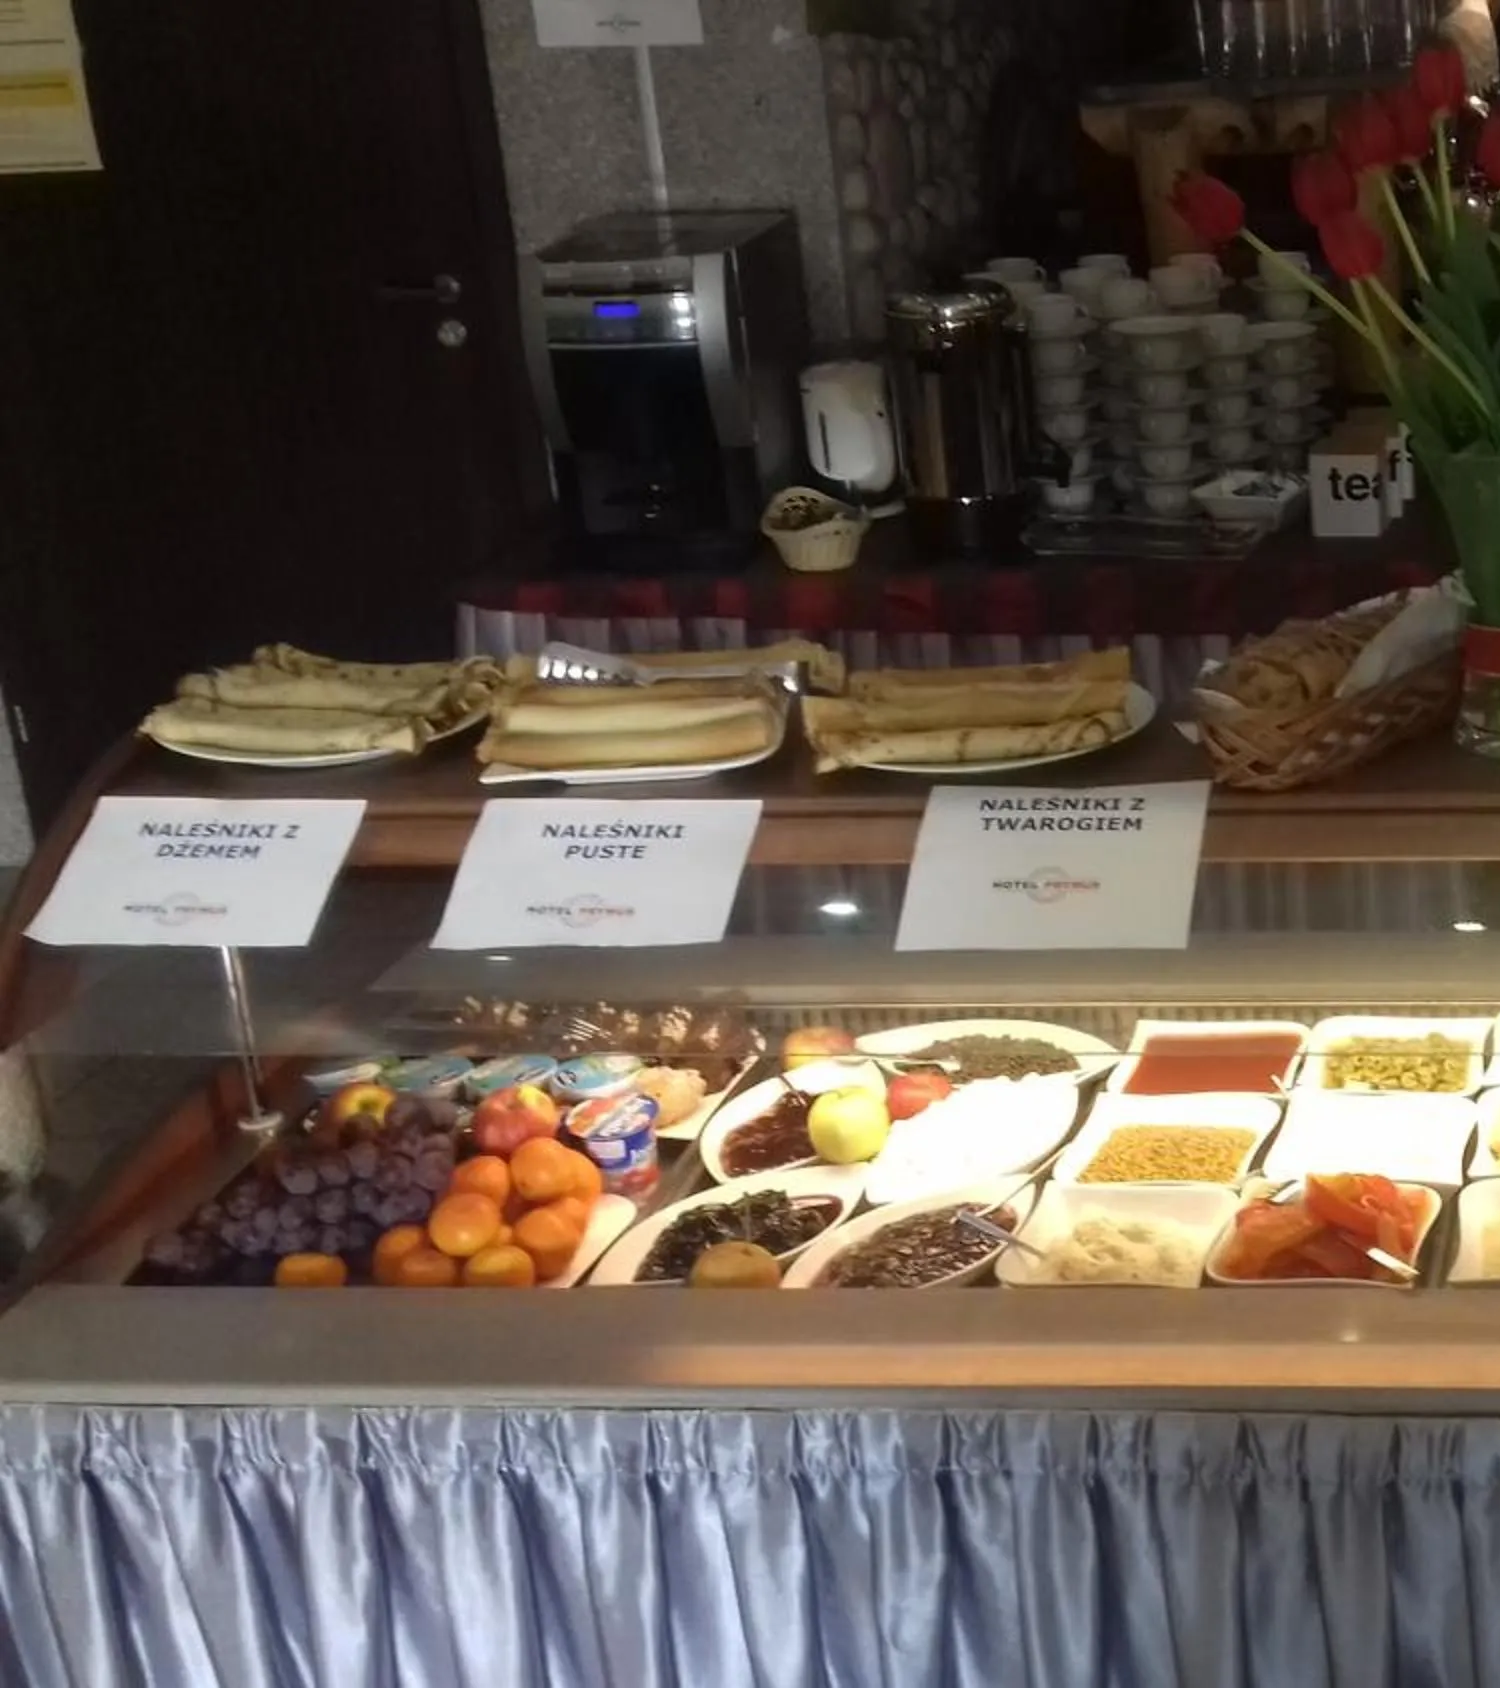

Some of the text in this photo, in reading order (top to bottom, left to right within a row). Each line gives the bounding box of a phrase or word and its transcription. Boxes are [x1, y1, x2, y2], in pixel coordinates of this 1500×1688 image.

[1129, 797, 1146, 811] Z
[282, 824, 301, 839] Z
[541, 819, 687, 839] NALEŚNIKI
[980, 817, 1143, 832] TWAROGIEM
[564, 845, 648, 859] PUSTE
